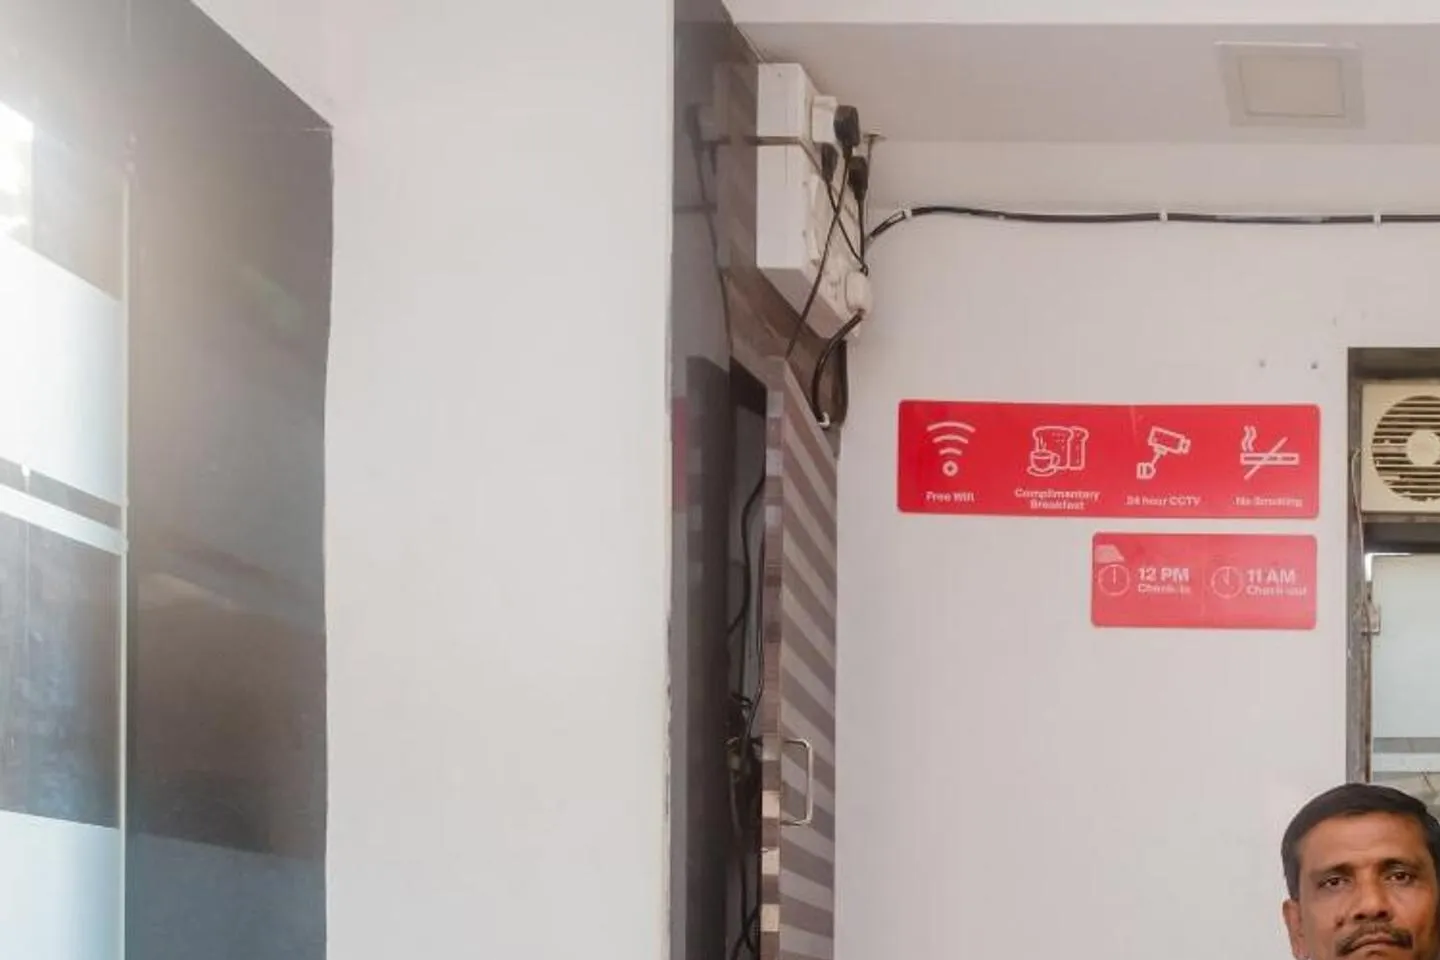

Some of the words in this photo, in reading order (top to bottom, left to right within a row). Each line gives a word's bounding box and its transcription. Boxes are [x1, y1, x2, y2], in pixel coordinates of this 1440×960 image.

[926, 491, 952, 503] Free
[1014, 488, 1101, 502] Complimentary
[1169, 495, 1201, 507] CCTV
[1030, 499, 1085, 510] Breakfast
[1138, 567, 1157, 581] 12
[1160, 567, 1189, 582] PM
[1246, 568, 1262, 583] 11
[1266, 568, 1296, 584] AM
